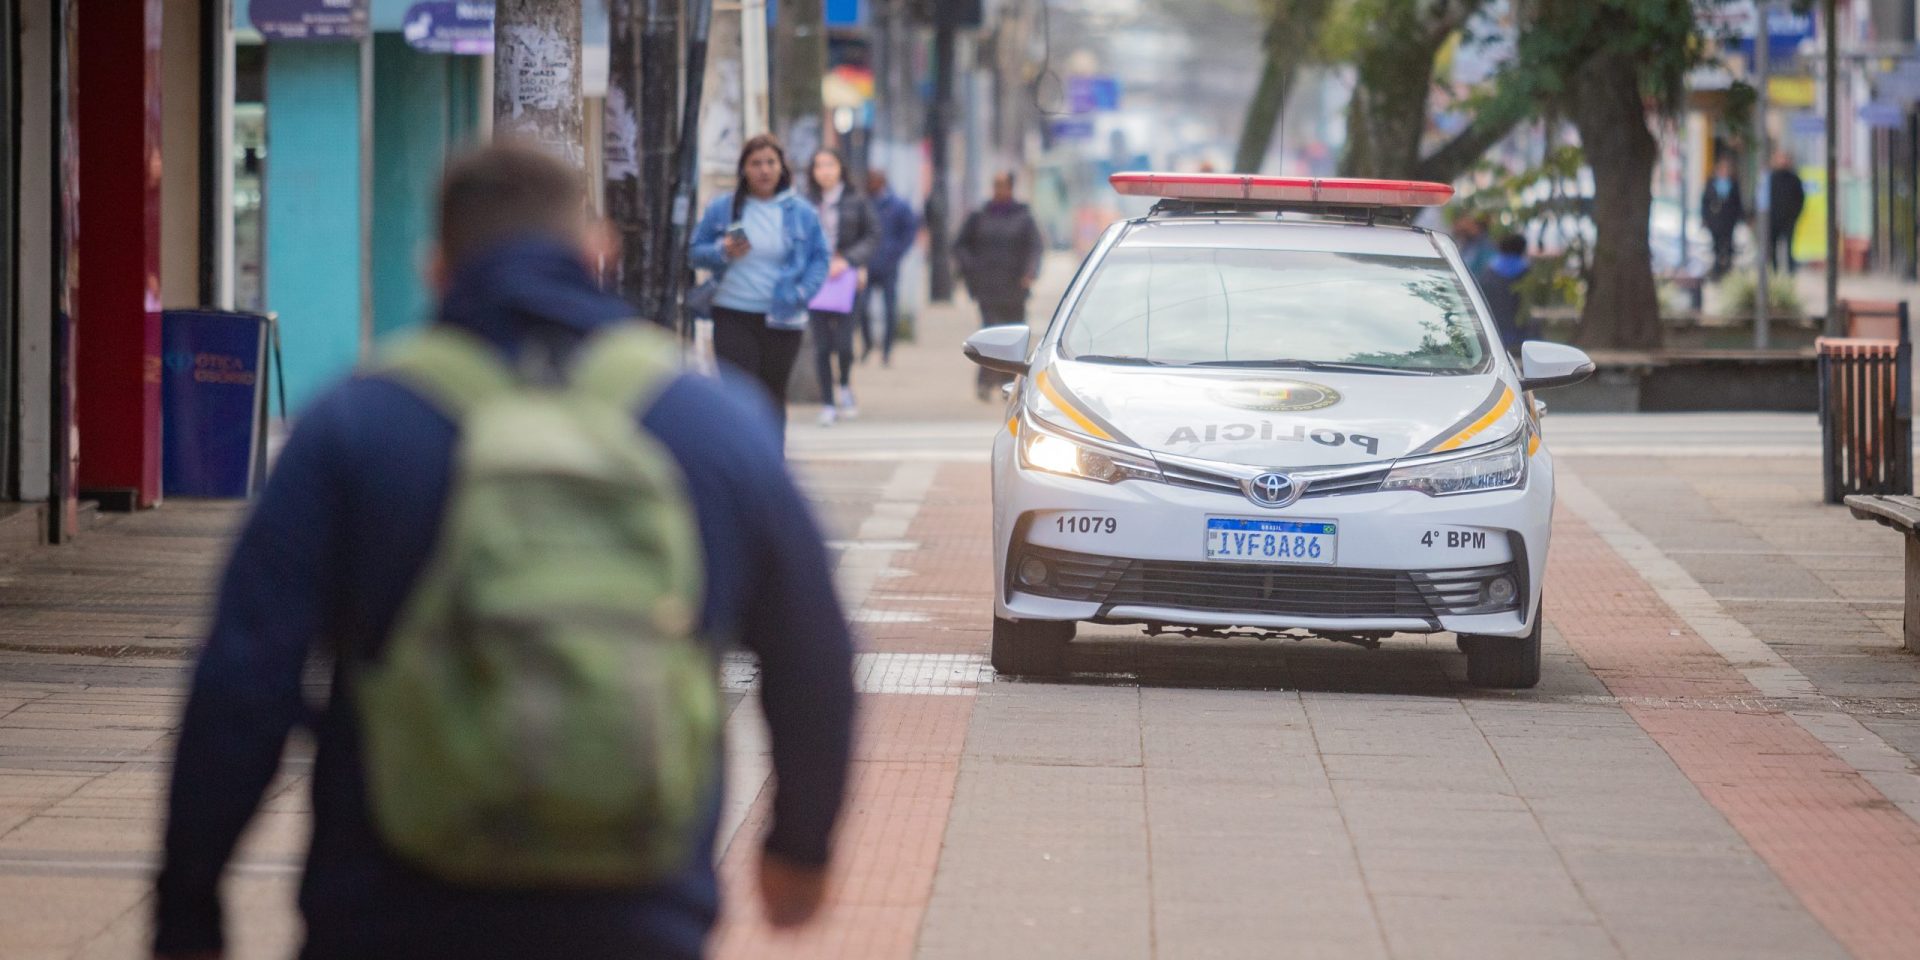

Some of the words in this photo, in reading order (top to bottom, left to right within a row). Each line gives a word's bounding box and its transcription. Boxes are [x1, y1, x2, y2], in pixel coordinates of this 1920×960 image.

[1056, 515, 1117, 534] 11079
[1218, 532, 1321, 558] IYF8A86
[1447, 531, 1486, 549] BPM
